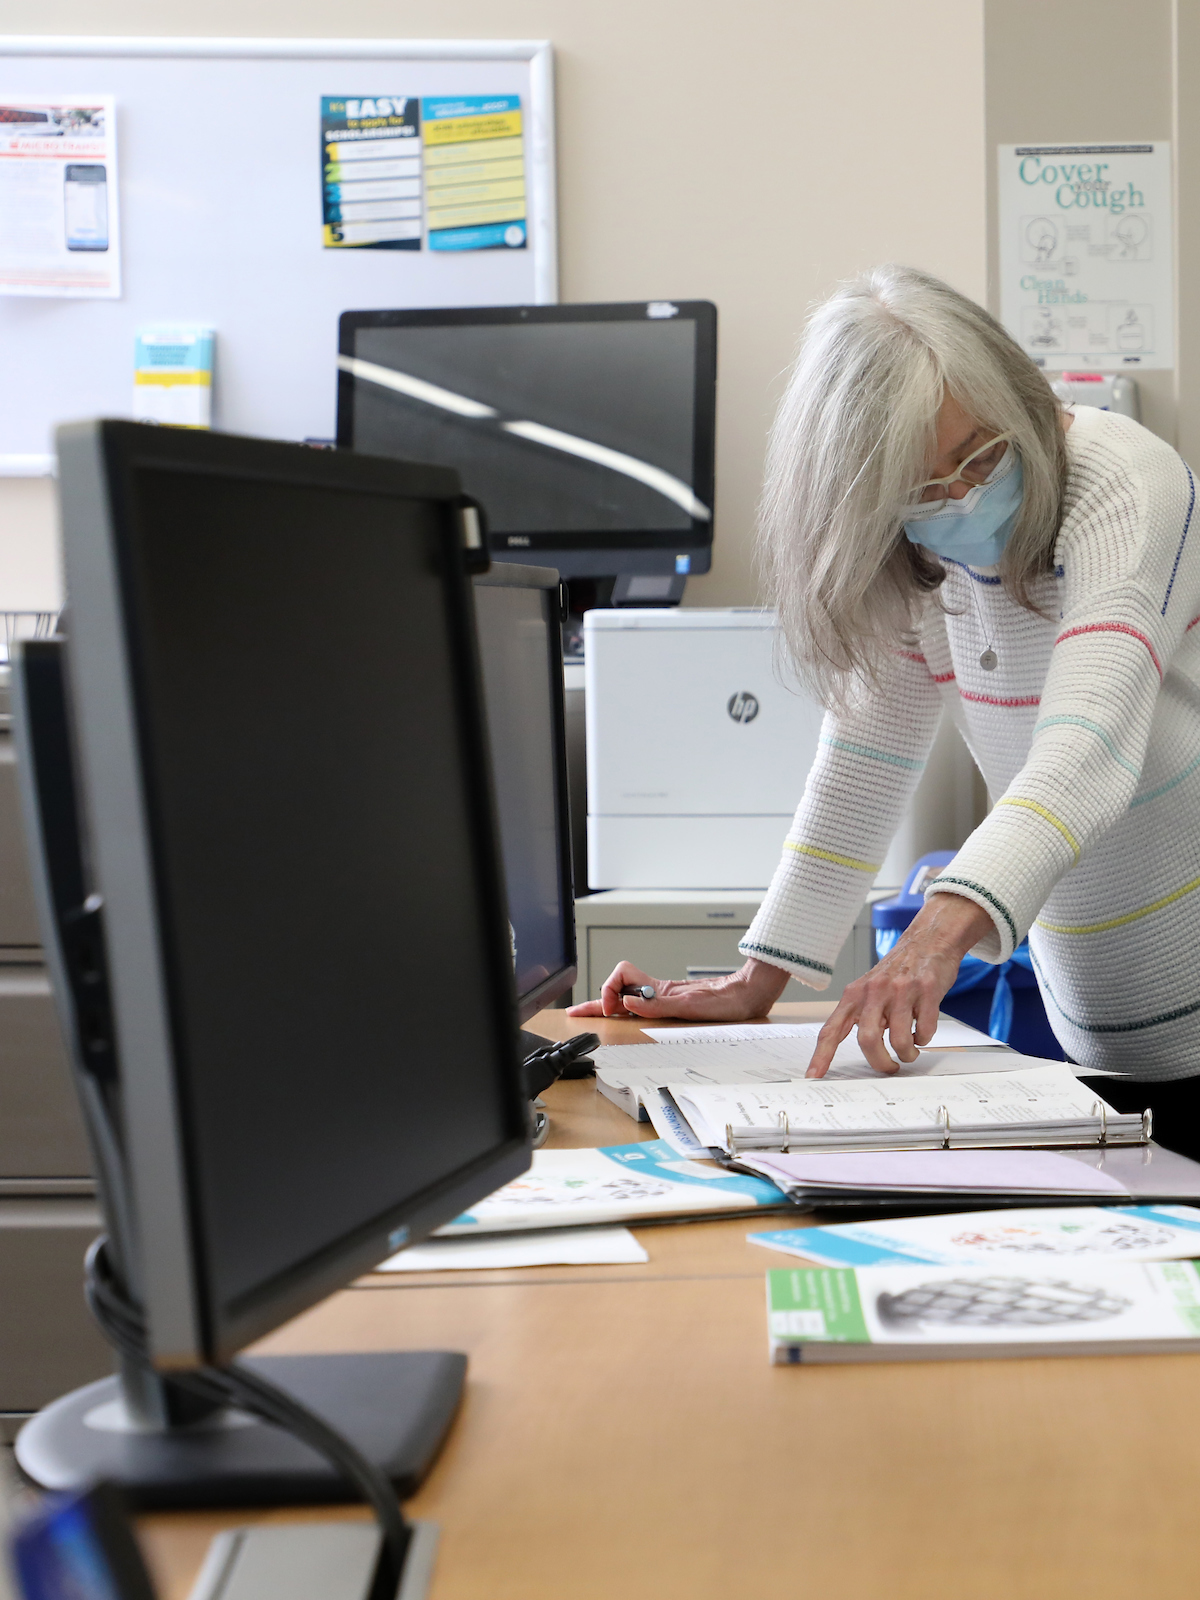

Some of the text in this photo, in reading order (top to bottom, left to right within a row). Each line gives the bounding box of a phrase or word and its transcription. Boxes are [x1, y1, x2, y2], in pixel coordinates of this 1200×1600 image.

[346, 97, 408, 118] EASY
[1019, 156, 1109, 185] Cover
[1055, 182, 1144, 214] Cough
[1020, 275, 1066, 290] Clean
[1038, 290, 1089, 304] Hands
[729, 691, 758, 724] hp
